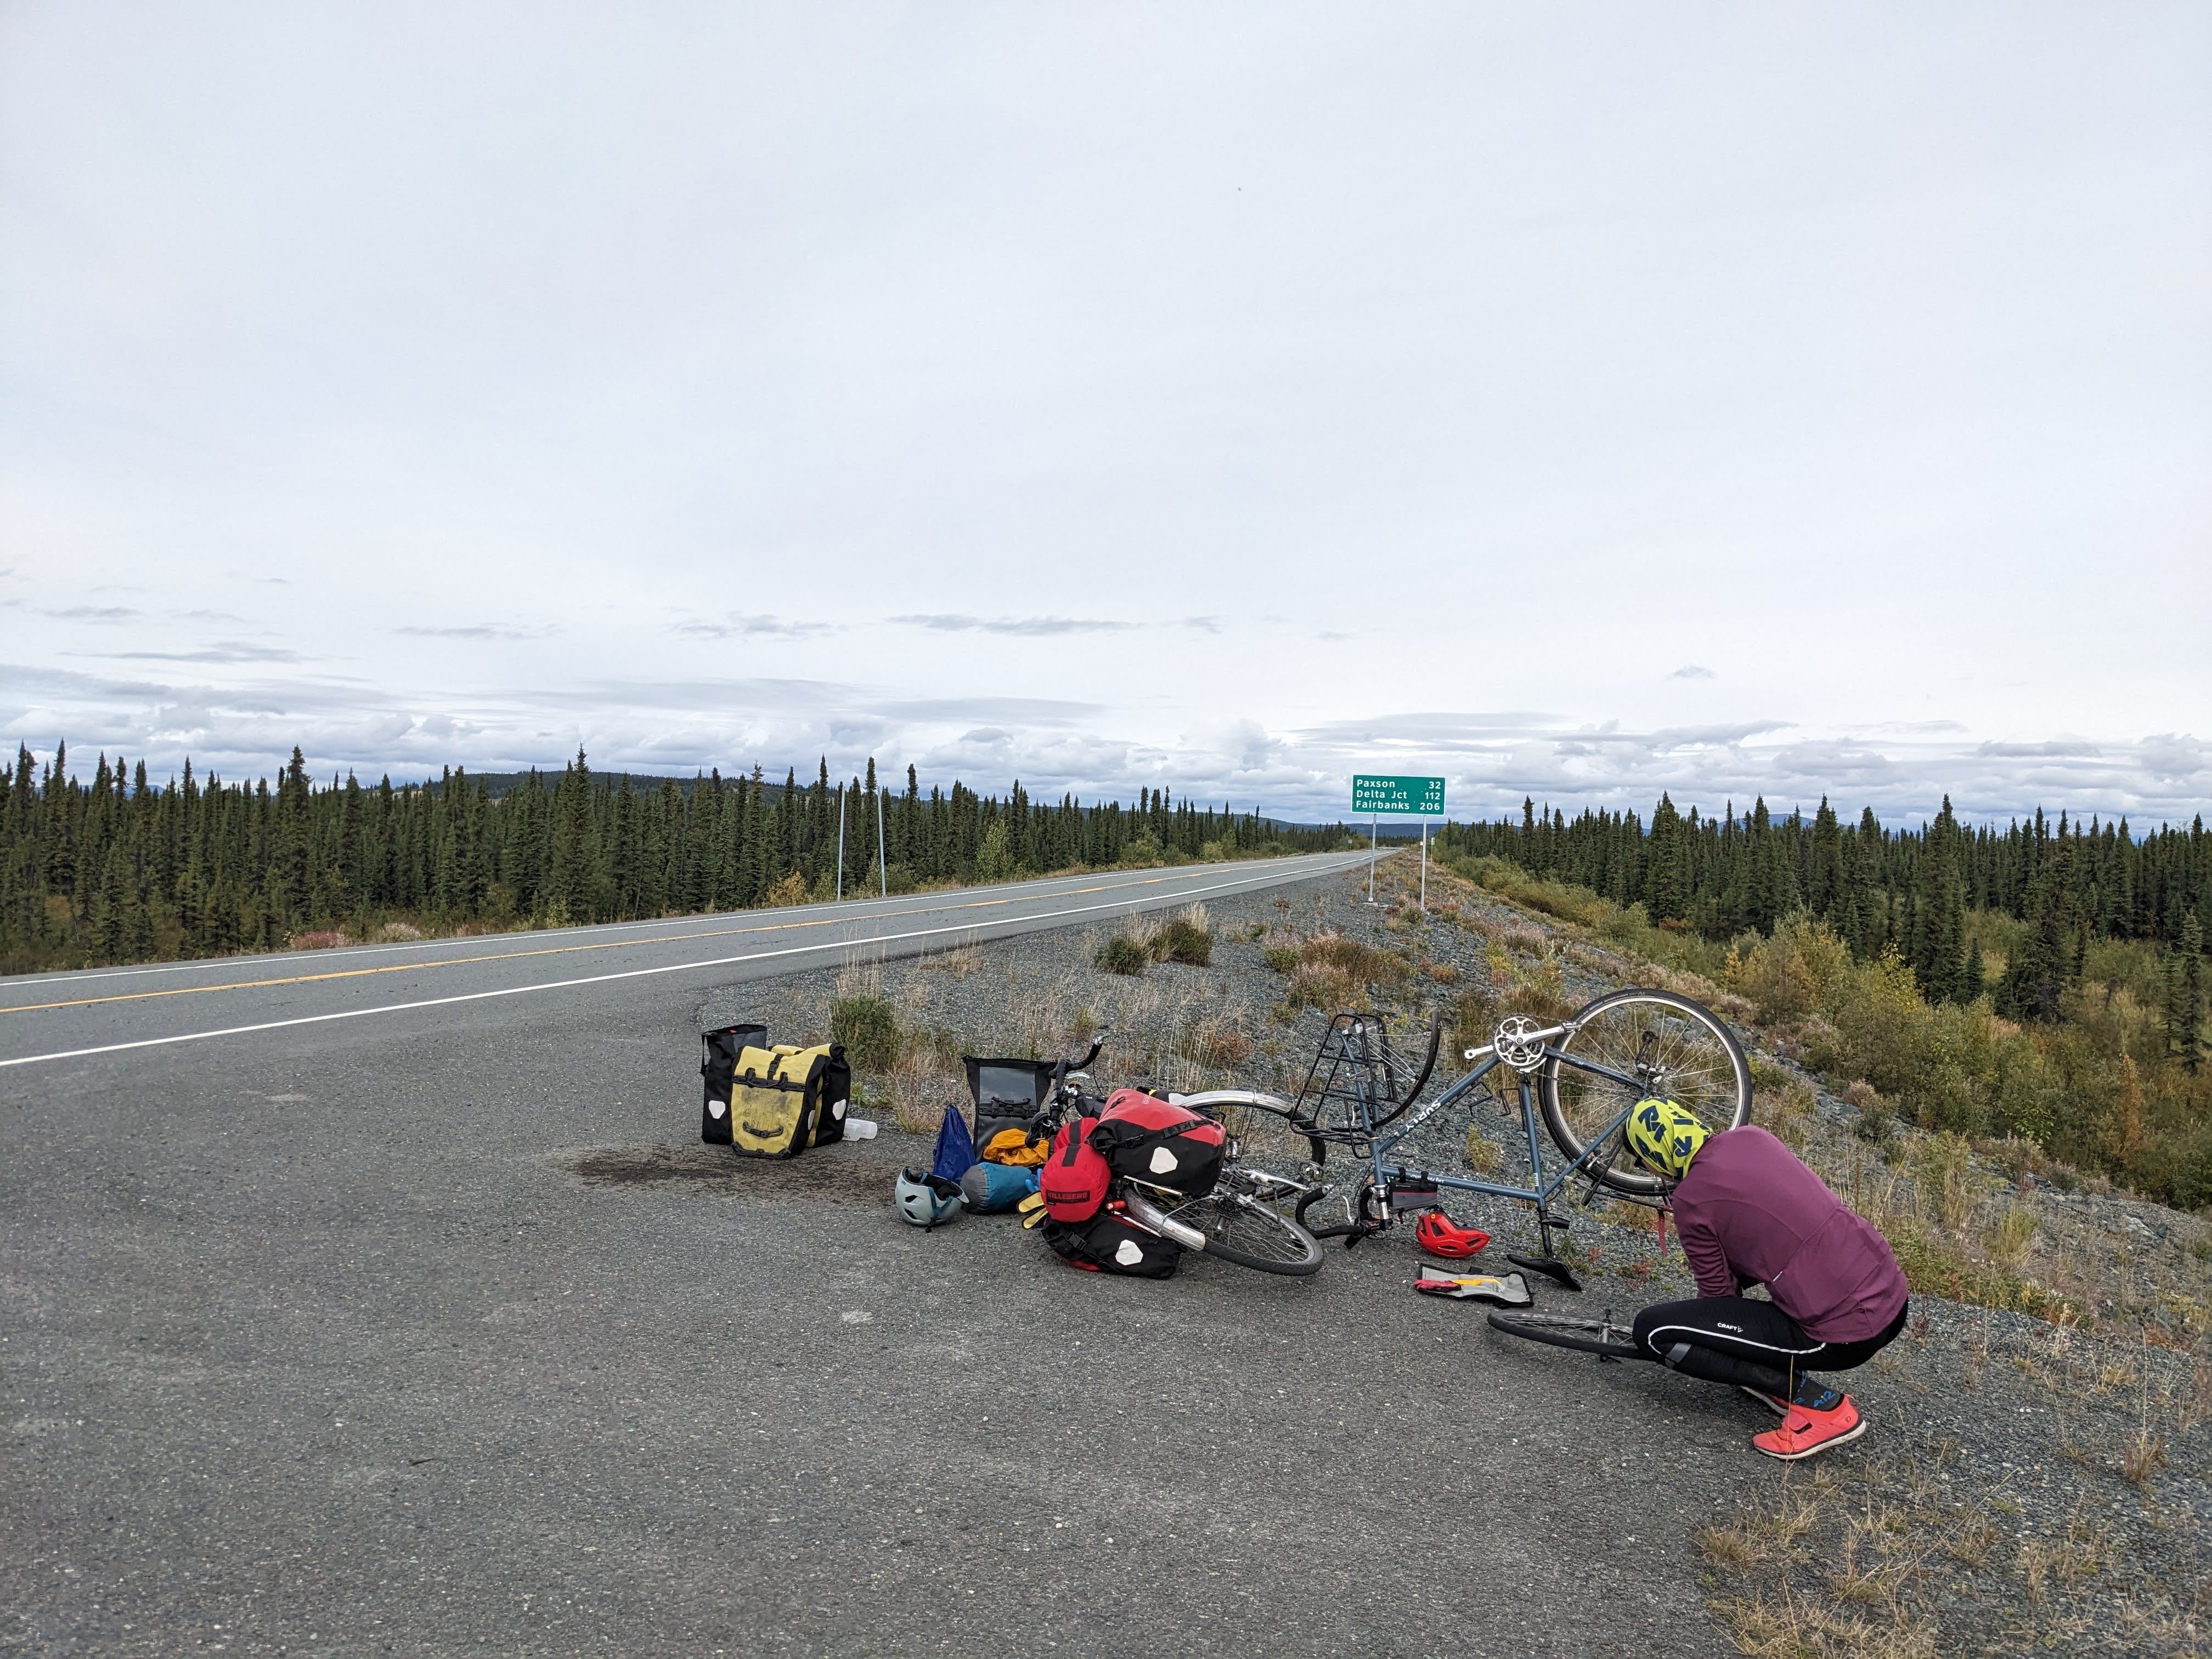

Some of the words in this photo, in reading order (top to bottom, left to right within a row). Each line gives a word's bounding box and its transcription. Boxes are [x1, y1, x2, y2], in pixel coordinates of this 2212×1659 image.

[1357, 779, 1395, 788] Paxson
[1429, 781, 1441, 789] 32
[1356, 790, 1385, 798] Delta
[1356, 800, 1410, 810] Fairbanks
[1405, 1099, 1441, 1132] SURLY
[1717, 1322, 1737, 1330] CRAFT
